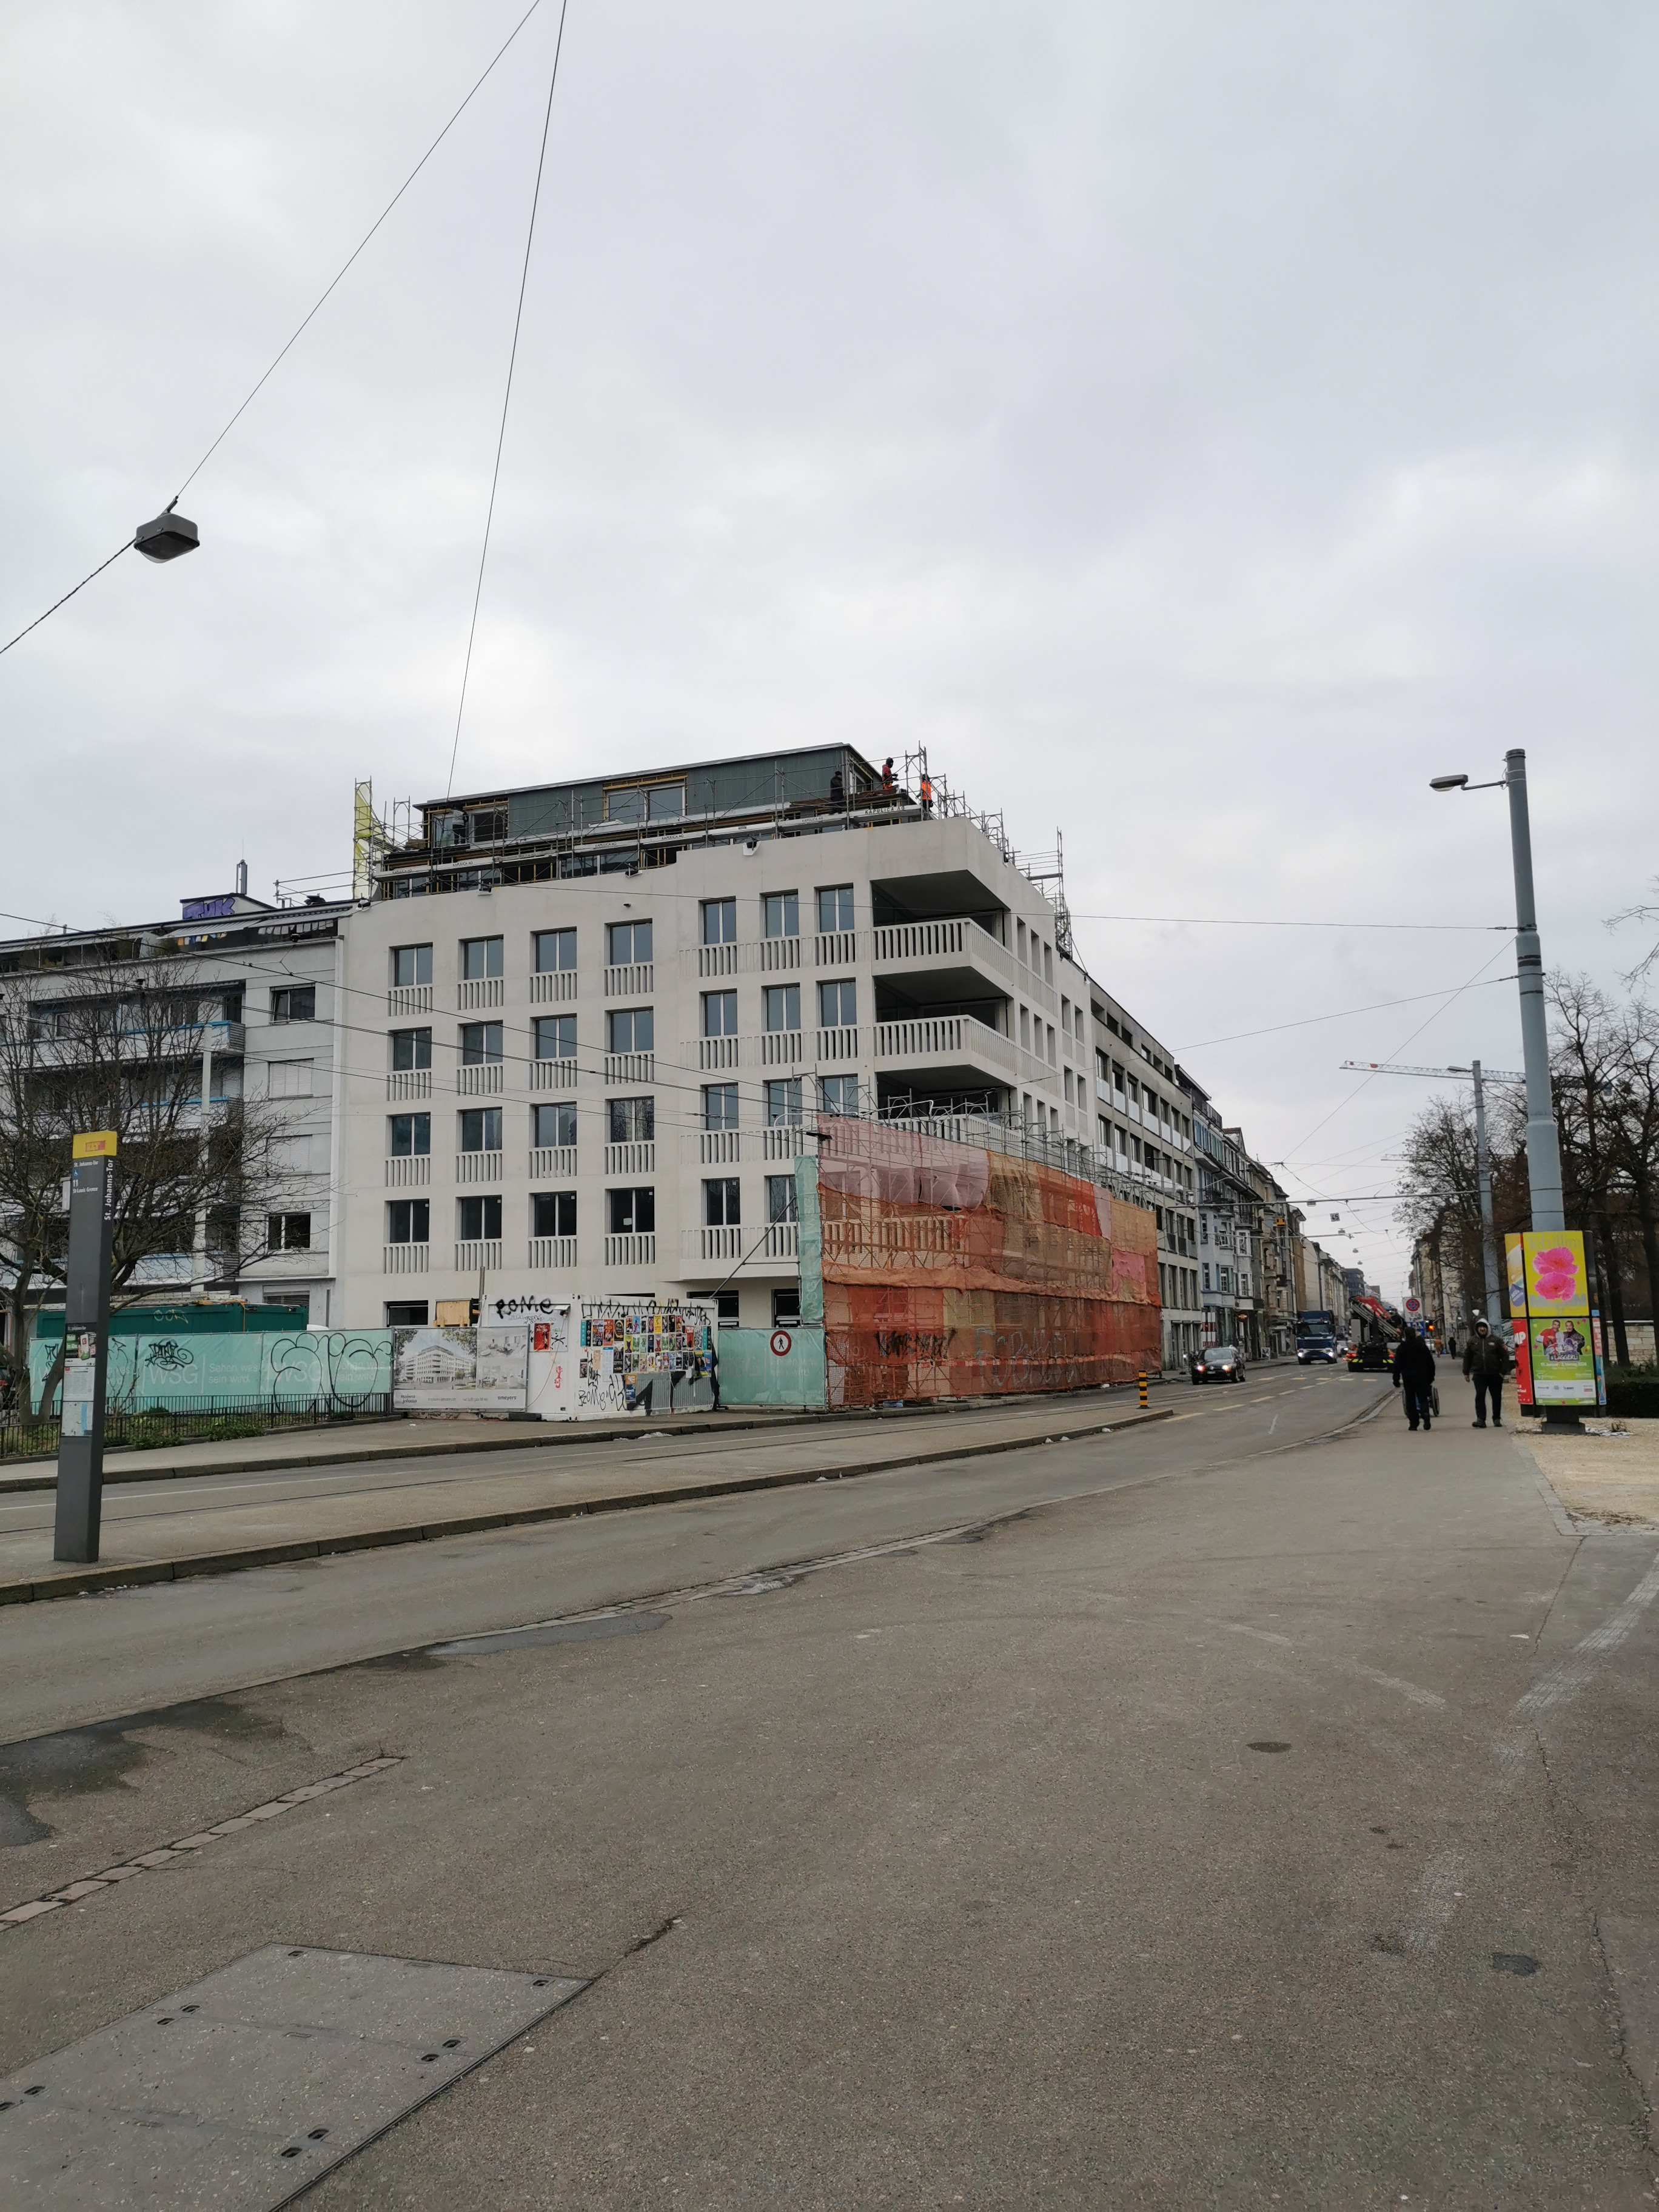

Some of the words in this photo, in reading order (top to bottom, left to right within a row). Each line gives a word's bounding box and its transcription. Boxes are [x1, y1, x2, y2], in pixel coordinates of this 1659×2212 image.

[104, 1159, 113, 1207] Johanns-Tor
[804, 1197, 816, 1230] WSG
[149, 1364, 198, 1384] WSG
[209, 1375, 227, 1383] sein
